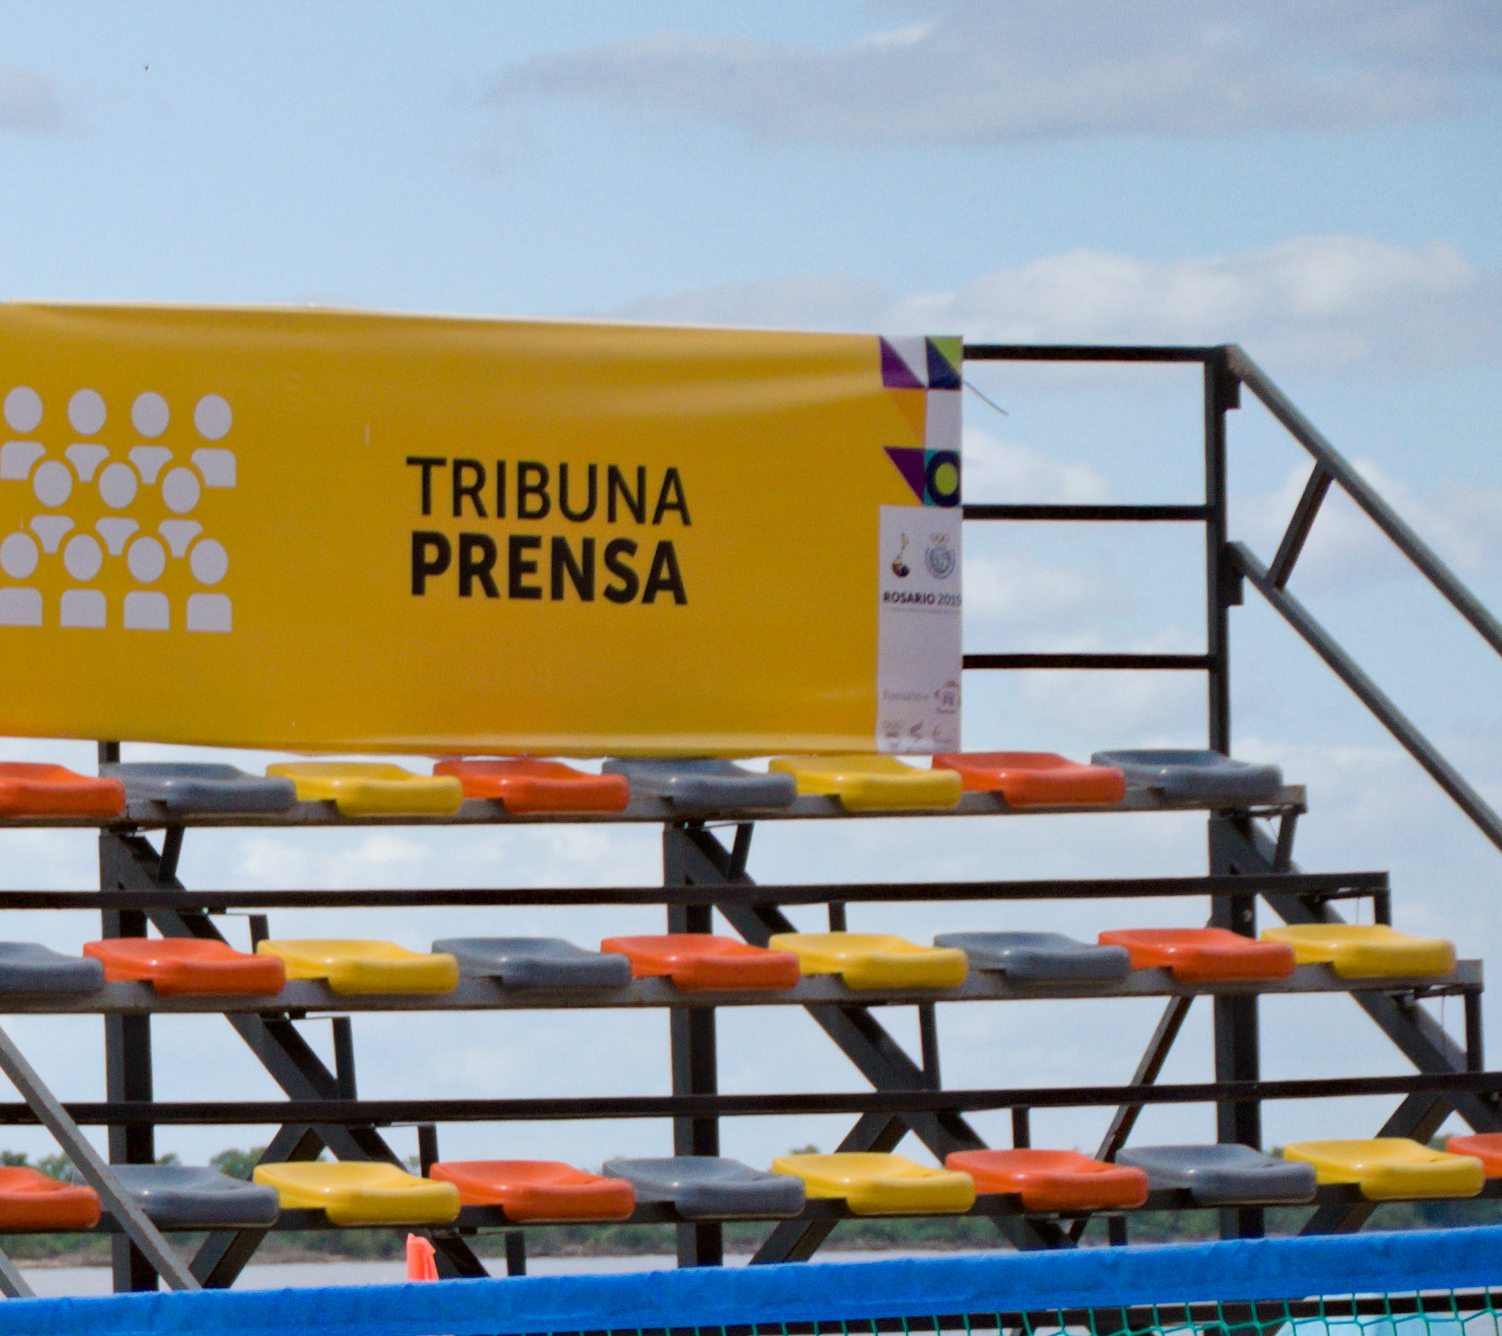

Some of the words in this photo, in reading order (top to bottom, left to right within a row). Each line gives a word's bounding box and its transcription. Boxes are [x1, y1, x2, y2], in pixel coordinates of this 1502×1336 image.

[406, 456, 693, 528] TRIBUNA
[410, 530, 689, 606] PRENSA
[882, 590, 936, 606] ROSARIO
[937, 593, 962, 607] 2019
